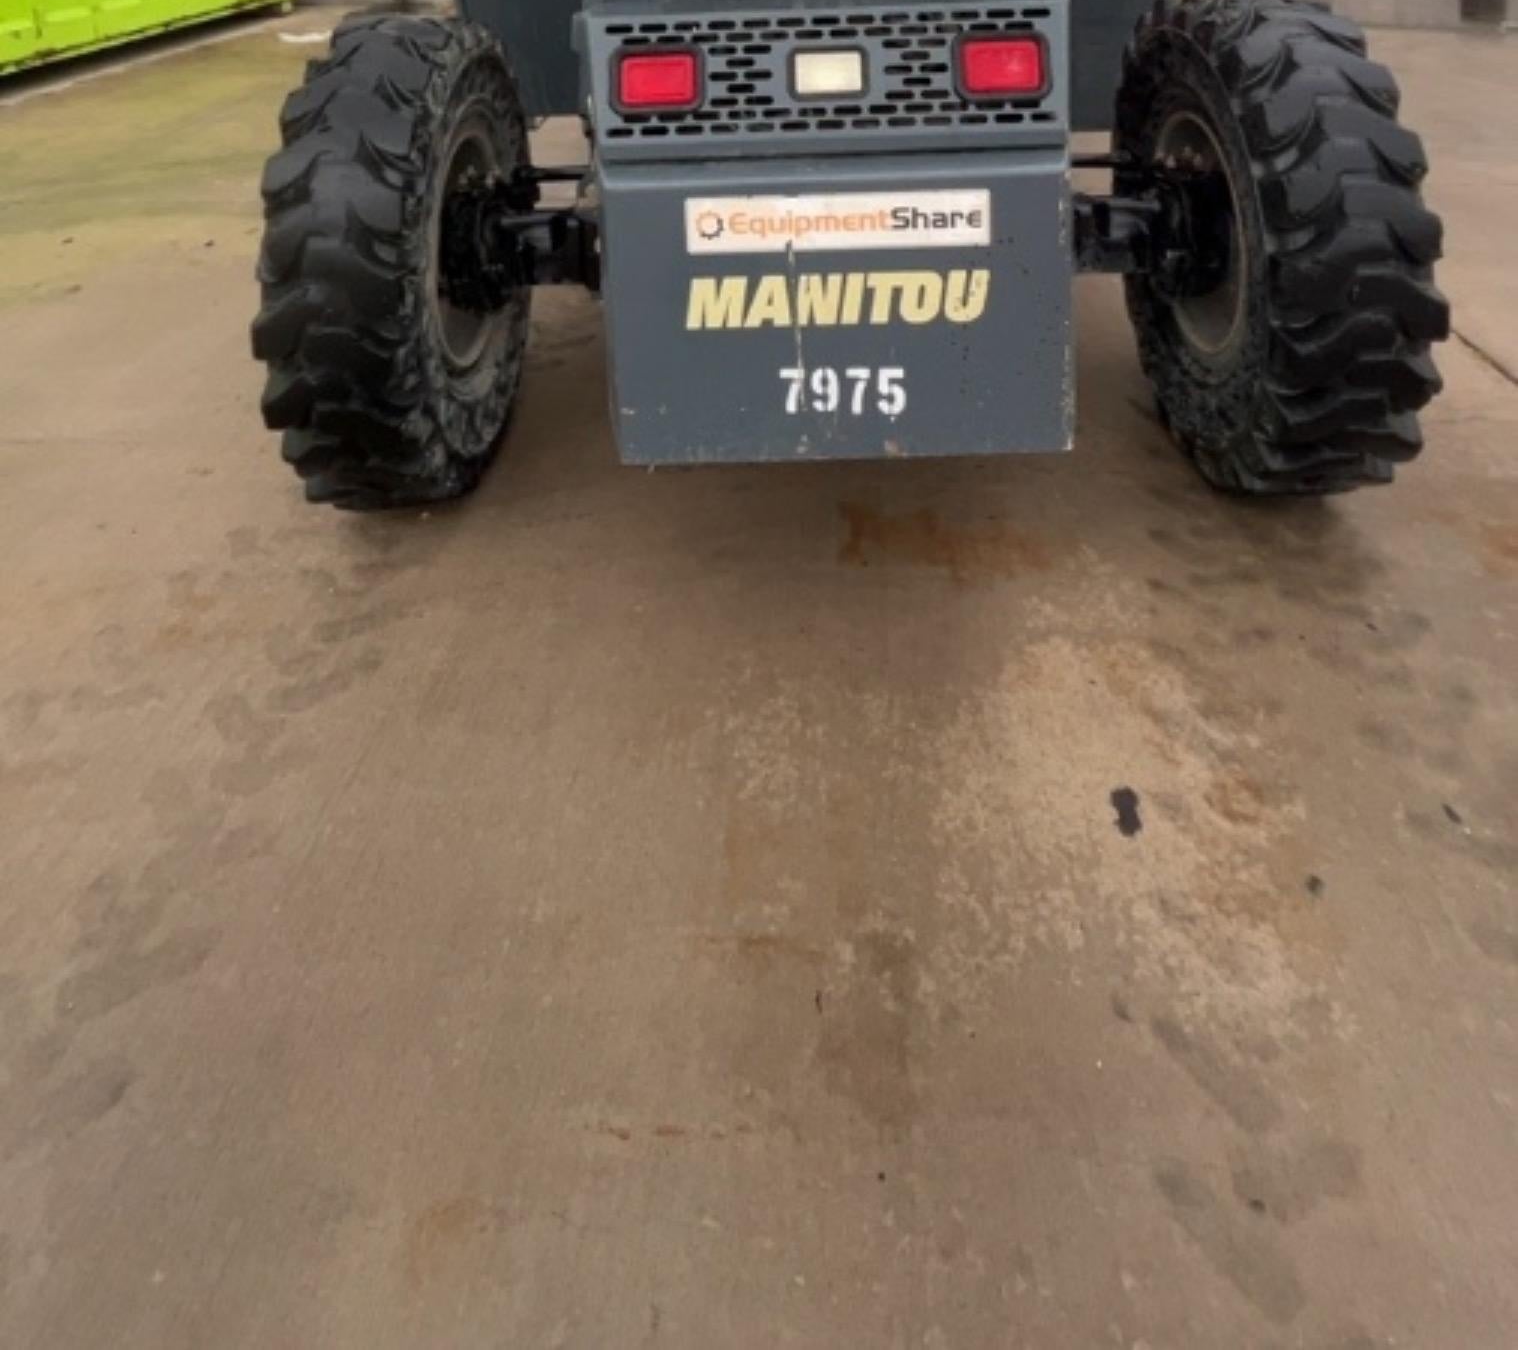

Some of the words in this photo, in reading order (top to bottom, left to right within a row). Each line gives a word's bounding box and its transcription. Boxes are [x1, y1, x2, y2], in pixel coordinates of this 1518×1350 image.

[728, 206, 982, 238] EquipmentShare
[686, 269, 990, 331] MANITOU
[779, 367, 907, 416] 7975
